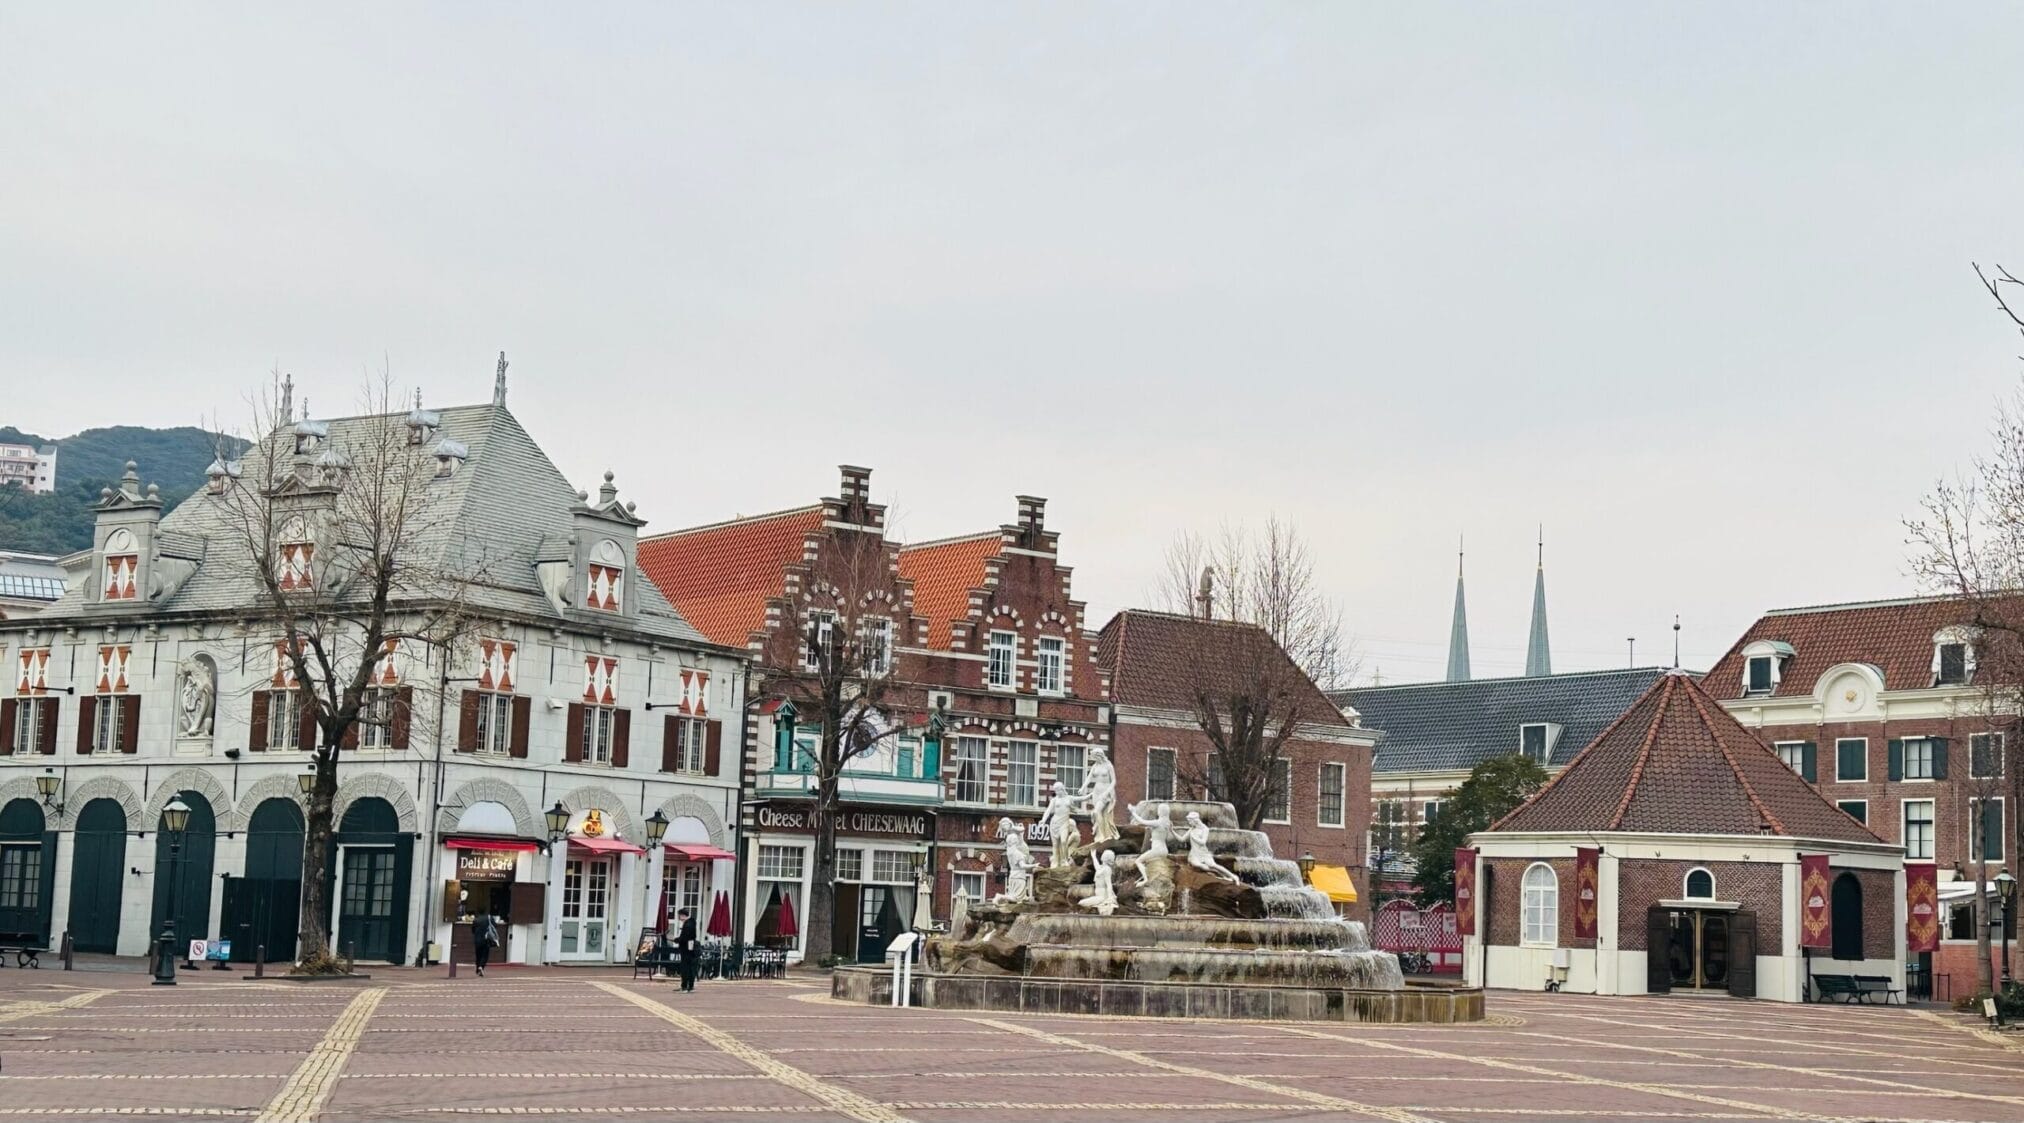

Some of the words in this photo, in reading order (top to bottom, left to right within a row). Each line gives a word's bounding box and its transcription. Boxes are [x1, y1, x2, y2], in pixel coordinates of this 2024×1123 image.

[759, 807, 803, 828] Cheese
[852, 813, 925, 834] CHEESEWAAG
[1027, 823, 1050, 841] 1992
[460, 857, 480, 869] Deli
[482, 858, 489, 869] &
[490, 859, 513, 871] Café
